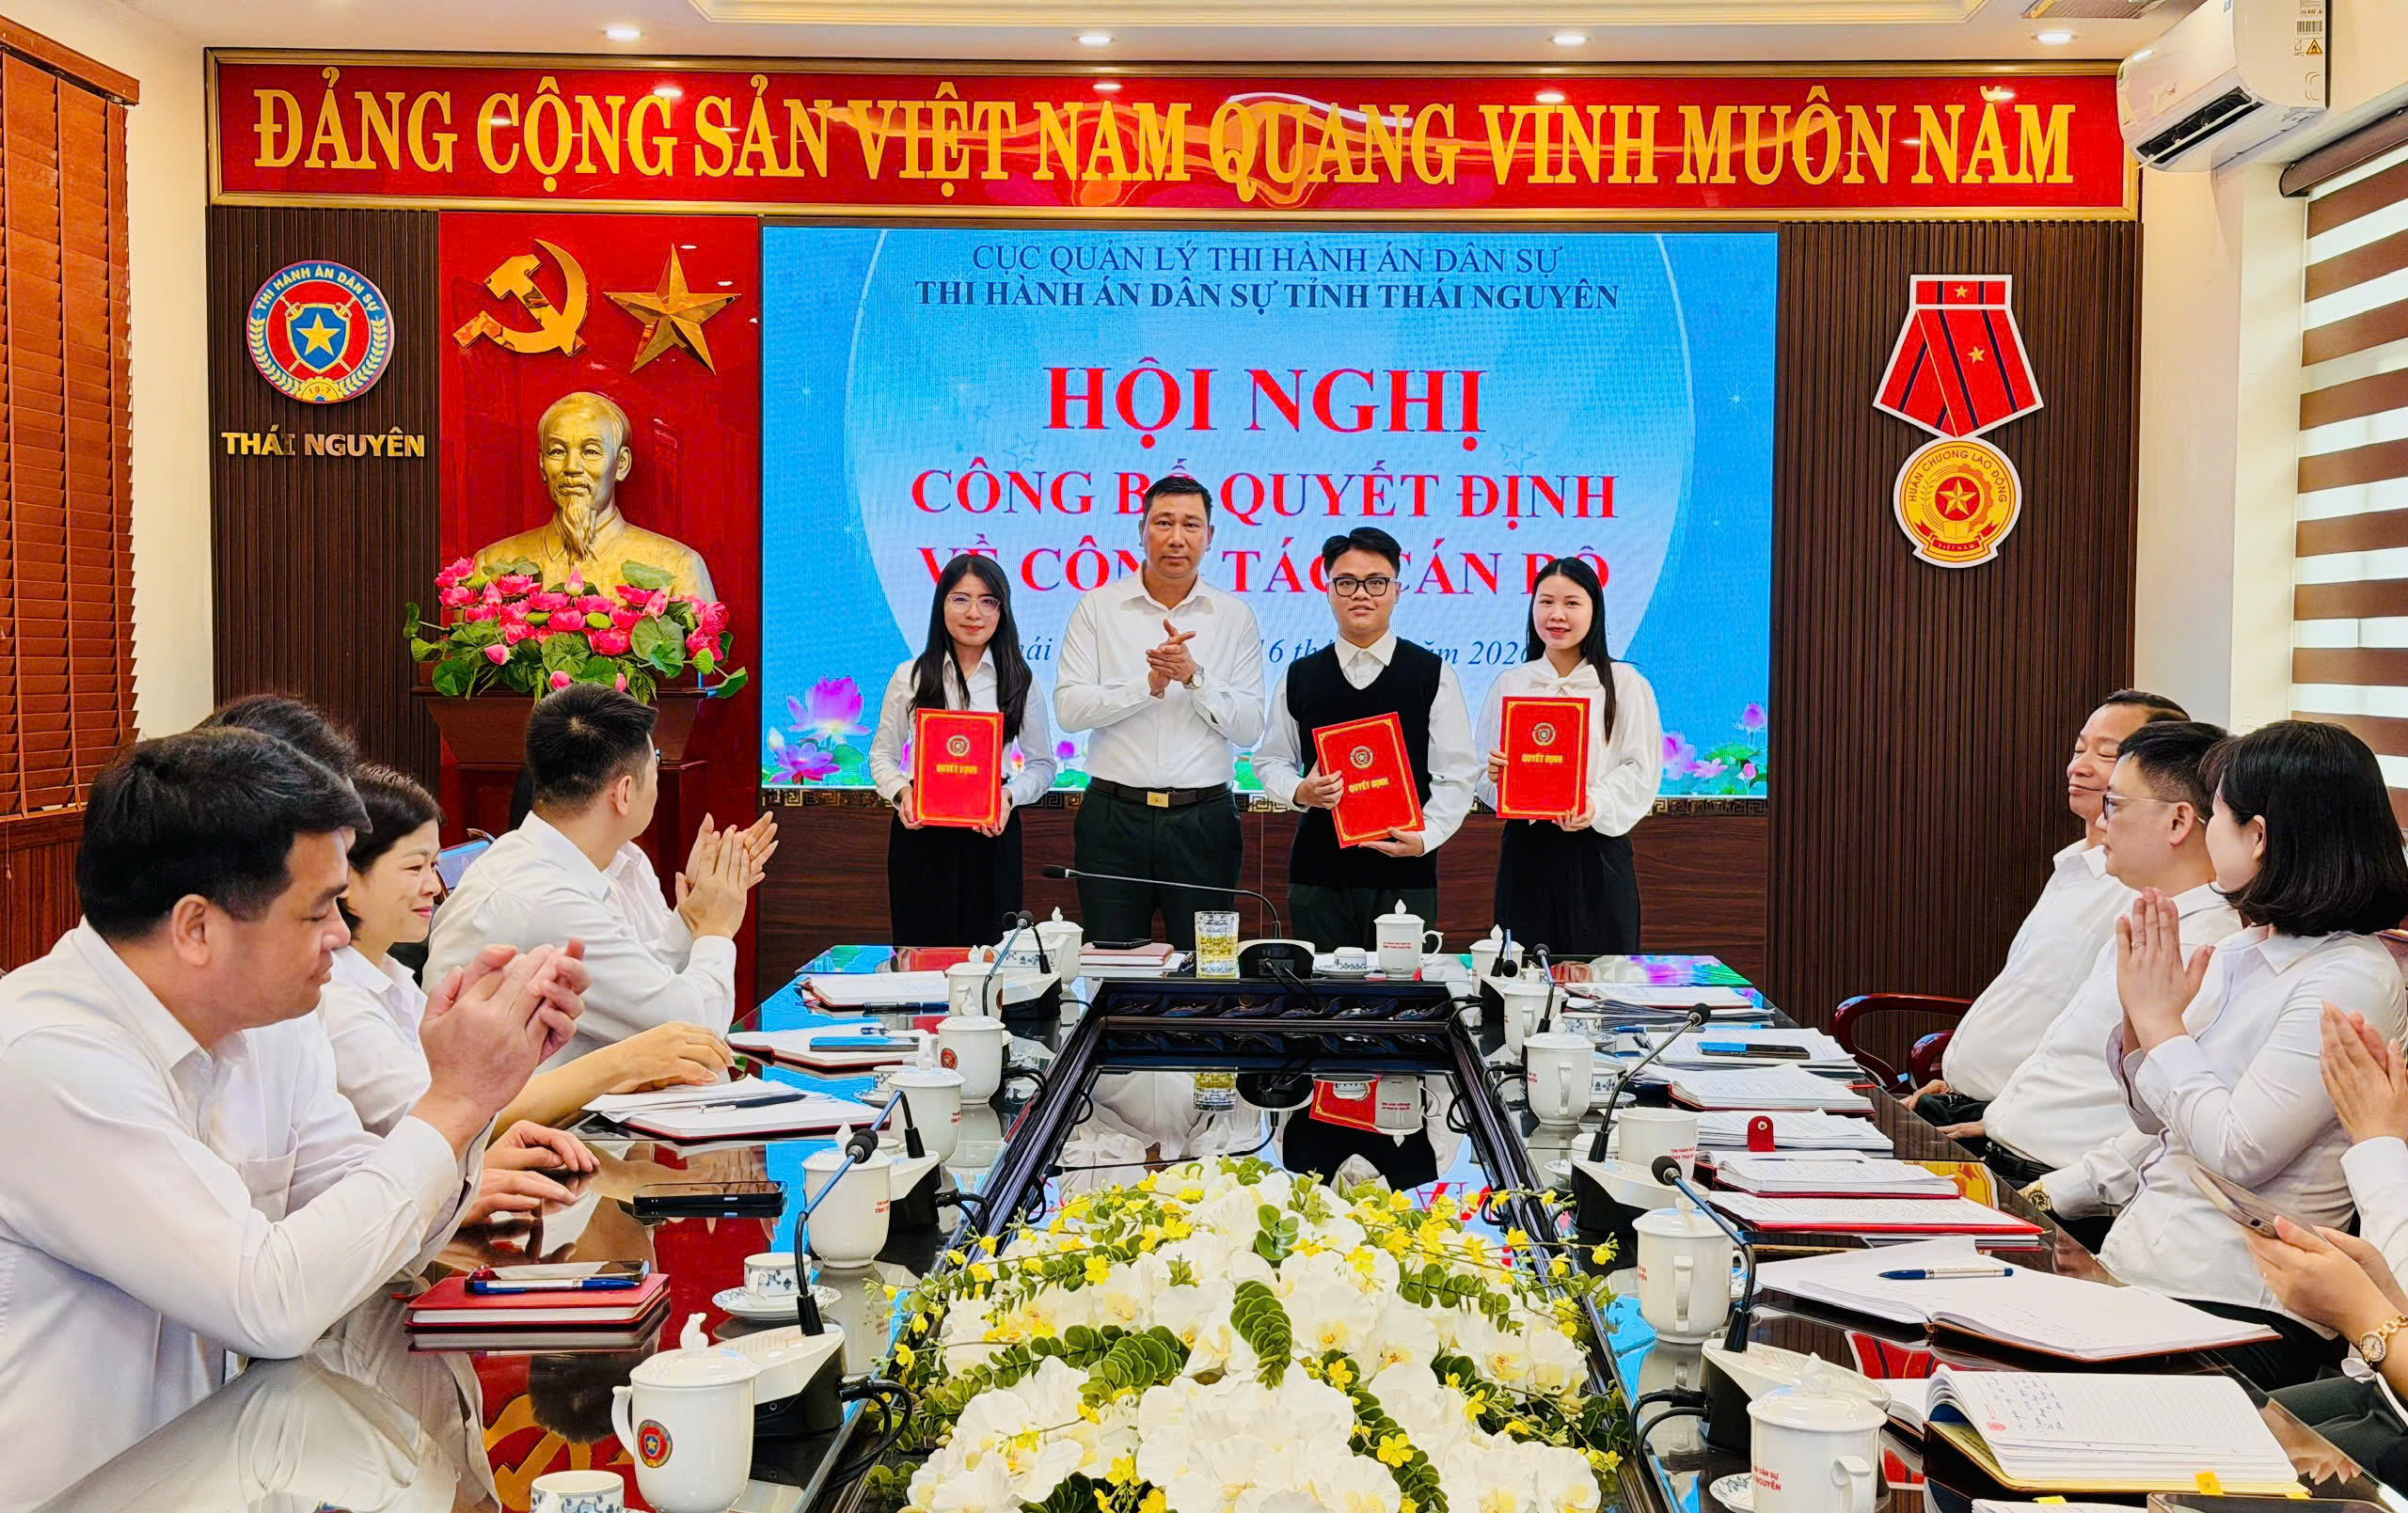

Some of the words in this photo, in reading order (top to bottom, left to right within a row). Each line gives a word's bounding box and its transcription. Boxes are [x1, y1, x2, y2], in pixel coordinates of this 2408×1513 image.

[254, 67, 457, 172] ĐẢNG
[477, 75, 677, 192] CỘNG
[694, 74, 833, 178] SẢN
[847, 82, 1016, 197] VIỆT
[1033, 101, 1192, 181] NAM
[1210, 102, 1461, 202] QUANG
[1479, 103, 1659, 185] VINH
[1676, 86, 1890, 185] MUÔN
[1911, 86, 2076, 185] NĂM
[973, 244, 1040, 275] CỤC
[1051, 239, 1144, 276] QUẢN
[1156, 240, 1198, 271] LÝ
[1208, 246, 1263, 272] THI
[1273, 241, 1368, 272] HÀNH
[1376, 241, 1423, 273] ÁN
[1434, 241, 1505, 273] DÂN
[1515, 245, 1563, 279] SỰ
[256, 288, 276, 310] THI
[273, 267, 311, 291] HÀNH
[915, 281, 975, 306] THI
[985, 275, 1086, 307] HÀNH
[1093, 275, 1141, 307] ÁN
[1150, 276, 1222, 307] DÂN
[1230, 279, 1279, 315] SỰ
[1284, 276, 1370, 308] TỈNH
[1378, 277, 1463, 309] THÁI
[1471, 277, 1620, 309] NGUYÊN
[1043, 356, 1218, 449] HỘI
[1244, 368, 1488, 452] NGHỊ
[221, 424, 295, 455] THÁI
[304, 426, 425, 458] NGUYÊN
[1972, 453, 1992, 469] LAO
[911, 456, 1097, 515] CÔNG
[1220, 461, 1439, 528] QUYẾT
[1456, 474, 1620, 530] ĐỊNH
